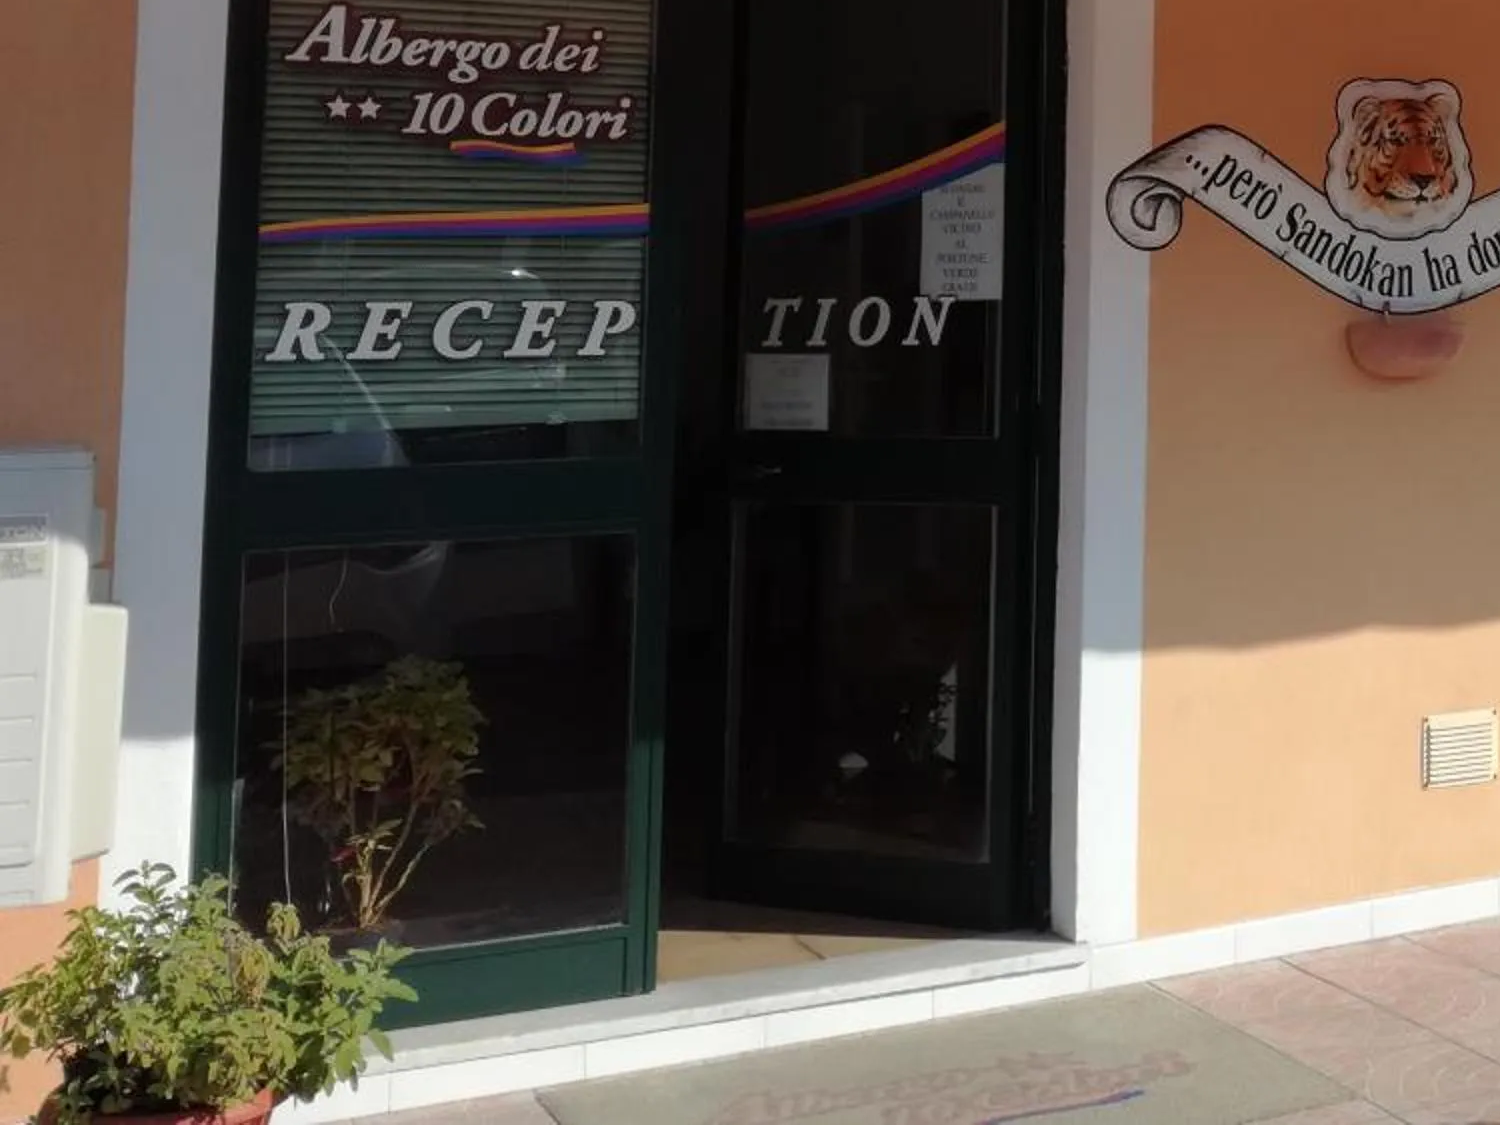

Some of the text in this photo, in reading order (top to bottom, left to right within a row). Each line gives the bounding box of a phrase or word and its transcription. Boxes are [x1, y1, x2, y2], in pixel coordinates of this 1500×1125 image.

[285, 4, 603, 83] Albergo dei
[402, 92, 632, 139] 10 Colori
[1276, 203, 1414, 299] Sandokan
[1422, 246, 1462, 293] ha
[265, 296, 957, 362] RECEP TION
